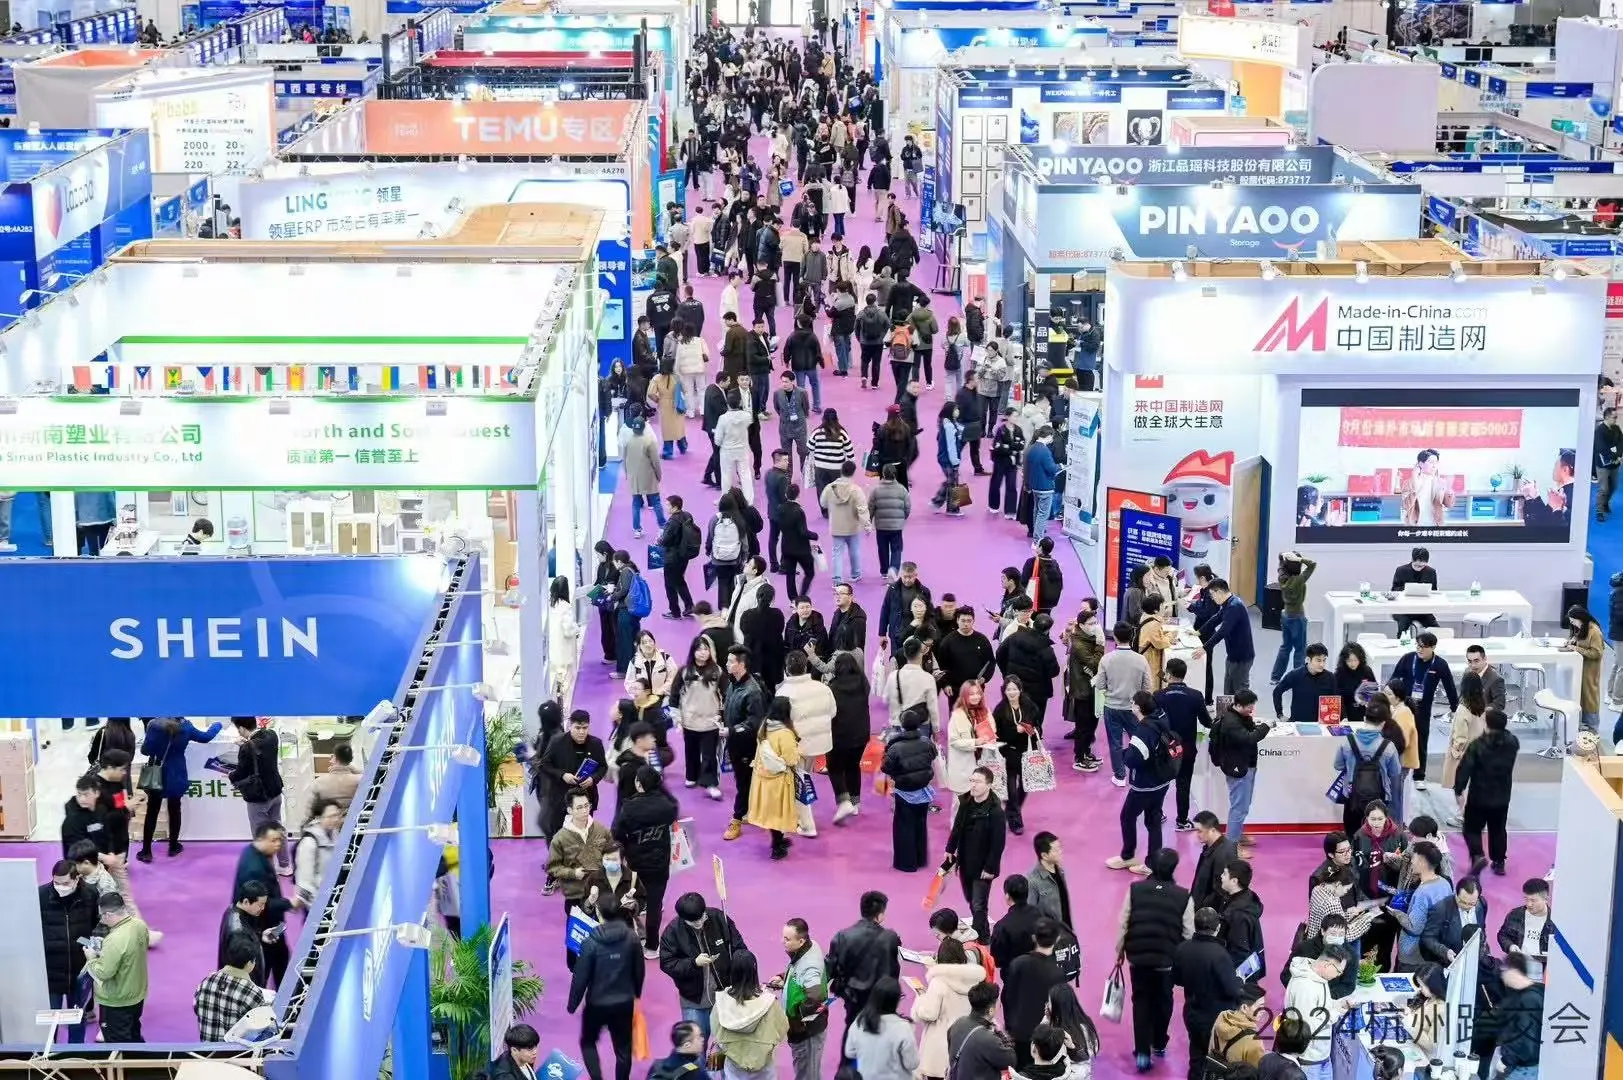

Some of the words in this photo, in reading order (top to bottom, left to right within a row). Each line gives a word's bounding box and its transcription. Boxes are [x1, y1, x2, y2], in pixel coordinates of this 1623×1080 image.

[183, 141, 209, 150] 2000
[1038, 157, 1144, 175] PINYAOO
[1148, 158, 1313, 173] 浙江品瑶科技股份有限公司
[375, 185, 403, 204] 领星
[268, 219, 323, 240] 领星ERP
[326, 208, 420, 233] 市场占有率第一
[1139, 205, 1320, 235] PINYAOO
[1229, 238, 1260, 247] Storage
[1338, 304, 1488, 319] Made-in-China.com
[1337, 325, 1487, 352] 中国制造网
[1134, 400, 1223, 413] 来中国制造网
[1133, 415, 1223, 429] 做全球大生意
[348, 423, 384, 438] and
[47, 451, 90, 462] Plastic
[94, 451, 149, 464] Industry
[181, 451, 203, 462] Ltd
[355, 449, 420, 464] 信誉至上
[109, 617, 319, 660] SHEIN
